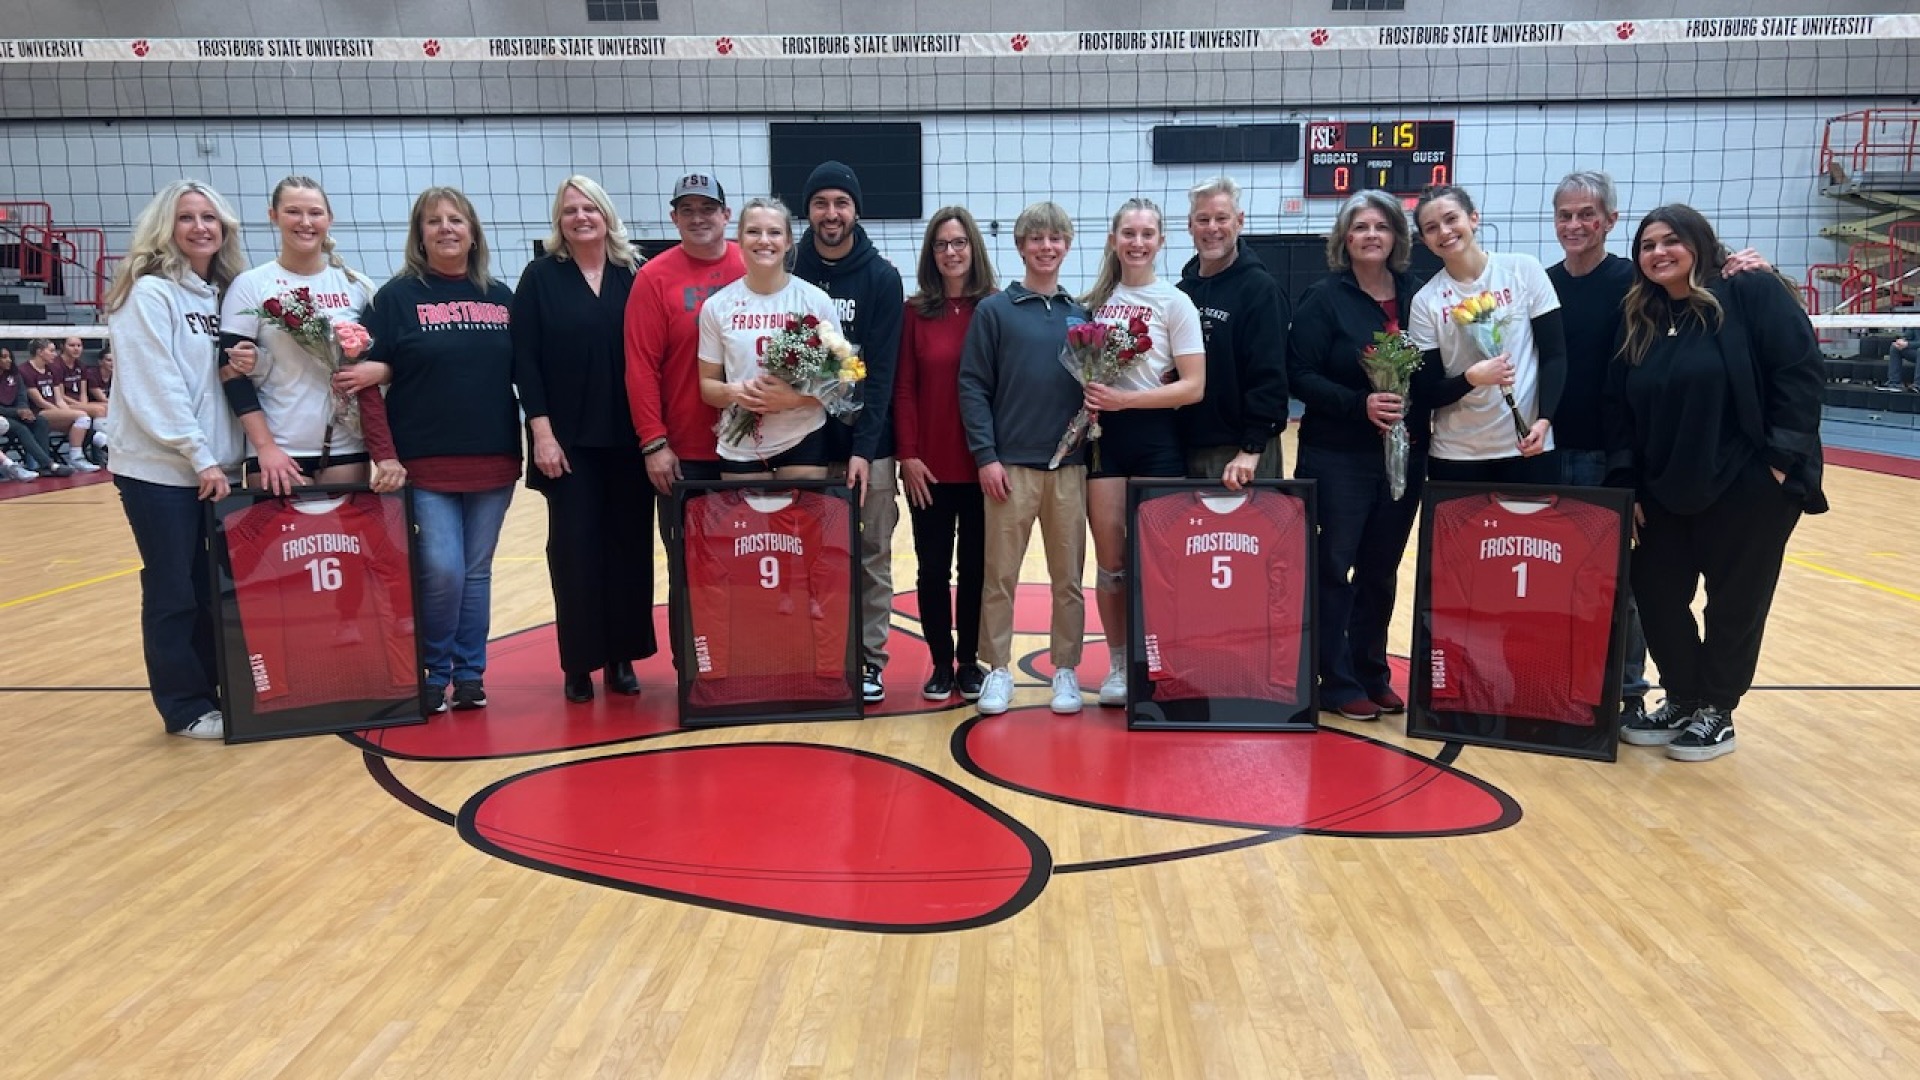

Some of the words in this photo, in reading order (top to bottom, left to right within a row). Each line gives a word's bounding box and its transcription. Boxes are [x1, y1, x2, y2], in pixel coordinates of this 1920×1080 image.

[1379, 26, 1449, 45] FROSTBURG
[1453, 25, 1488, 44] STATE
[1492, 24, 1565, 42] UNIVERSITY
[1685, 18, 1758, 37] FROSTBURG
[1761, 17, 1798, 36] STATE
[1802, 16, 1874, 35] UNIVERSITY
[17, 40, 84, 58] UNIVERSITY
[197, 39, 264, 57] FROSTBURG
[267, 39, 303, 57] STATE
[305, 39, 374, 57] UNIVERSITY
[489, 38, 556, 56] FROSTBURG
[560, 38, 594, 56] STATE
[598, 37, 666, 55] UNIVERSITY
[782, 36, 849, 54] FROSTBURG
[854, 36, 888, 54] STATE
[892, 34, 961, 53] UNIVERSITY
[1078, 32, 1146, 50] FROSTBURG
[1151, 31, 1186, 49] STATE
[1190, 30, 1260, 49] UNIVERSITY
[1371, 123, 1414, 148] 1:15
[1313, 152, 1359, 165] BOBCATS
[1367, 159, 1392, 168] PERIOD
[1412, 151, 1445, 163] GUEST
[682, 174, 708, 188] FSU
[1334, 167, 1349, 190] 0
[1379, 170, 1387, 187] 1
[1432, 165, 1447, 186] 0
[416, 300, 510, 324] FROSTBURG
[731, 313, 795, 331] FROSTBU
[282, 533, 360, 562] FROSTBURG
[734, 533, 803, 557] FROSTBURG
[1185, 532, 1260, 556] FROSTBURG
[1480, 536, 1562, 564] FROSTBURG
[304, 557, 343, 592] 16
[759, 556, 780, 589] 9
[1211, 556, 1233, 589] 5
[1511, 561, 1527, 598] 1
[694, 635, 712, 673] BOBCATS
[1145, 634, 1162, 672] BOBCATS
[249, 653, 271, 692] BOBCATS
[1431, 648, 1446, 689] BOBCATS
